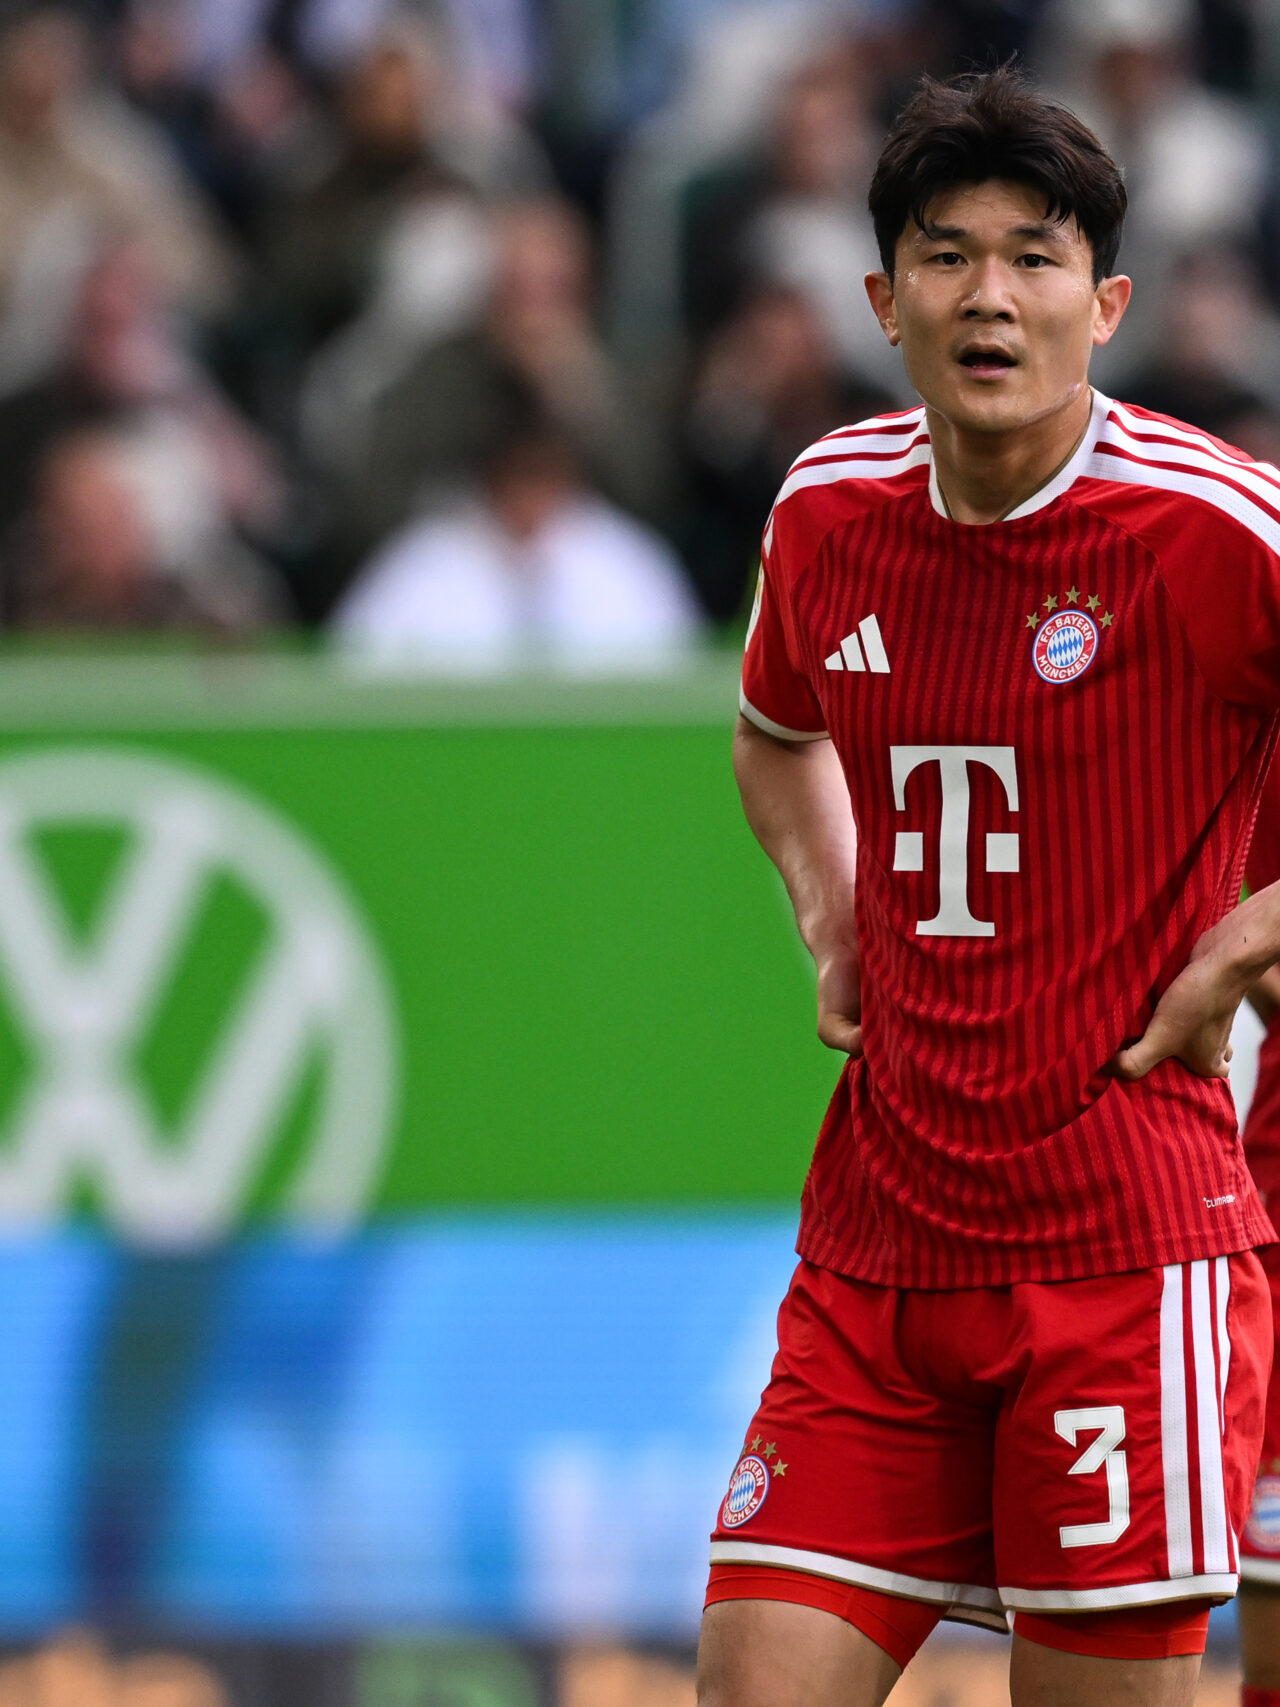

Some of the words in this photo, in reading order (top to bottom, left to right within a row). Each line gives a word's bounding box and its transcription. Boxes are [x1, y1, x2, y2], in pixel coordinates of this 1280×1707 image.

[1039, 627, 1054, 643] FC
[1055, 615, 1093, 642] BAYERN
[1038, 653, 1090, 680] MÜNCHEN
[740, 1461, 765, 1487] BAYERN
[1054, 1406, 1130, 1548] 3
